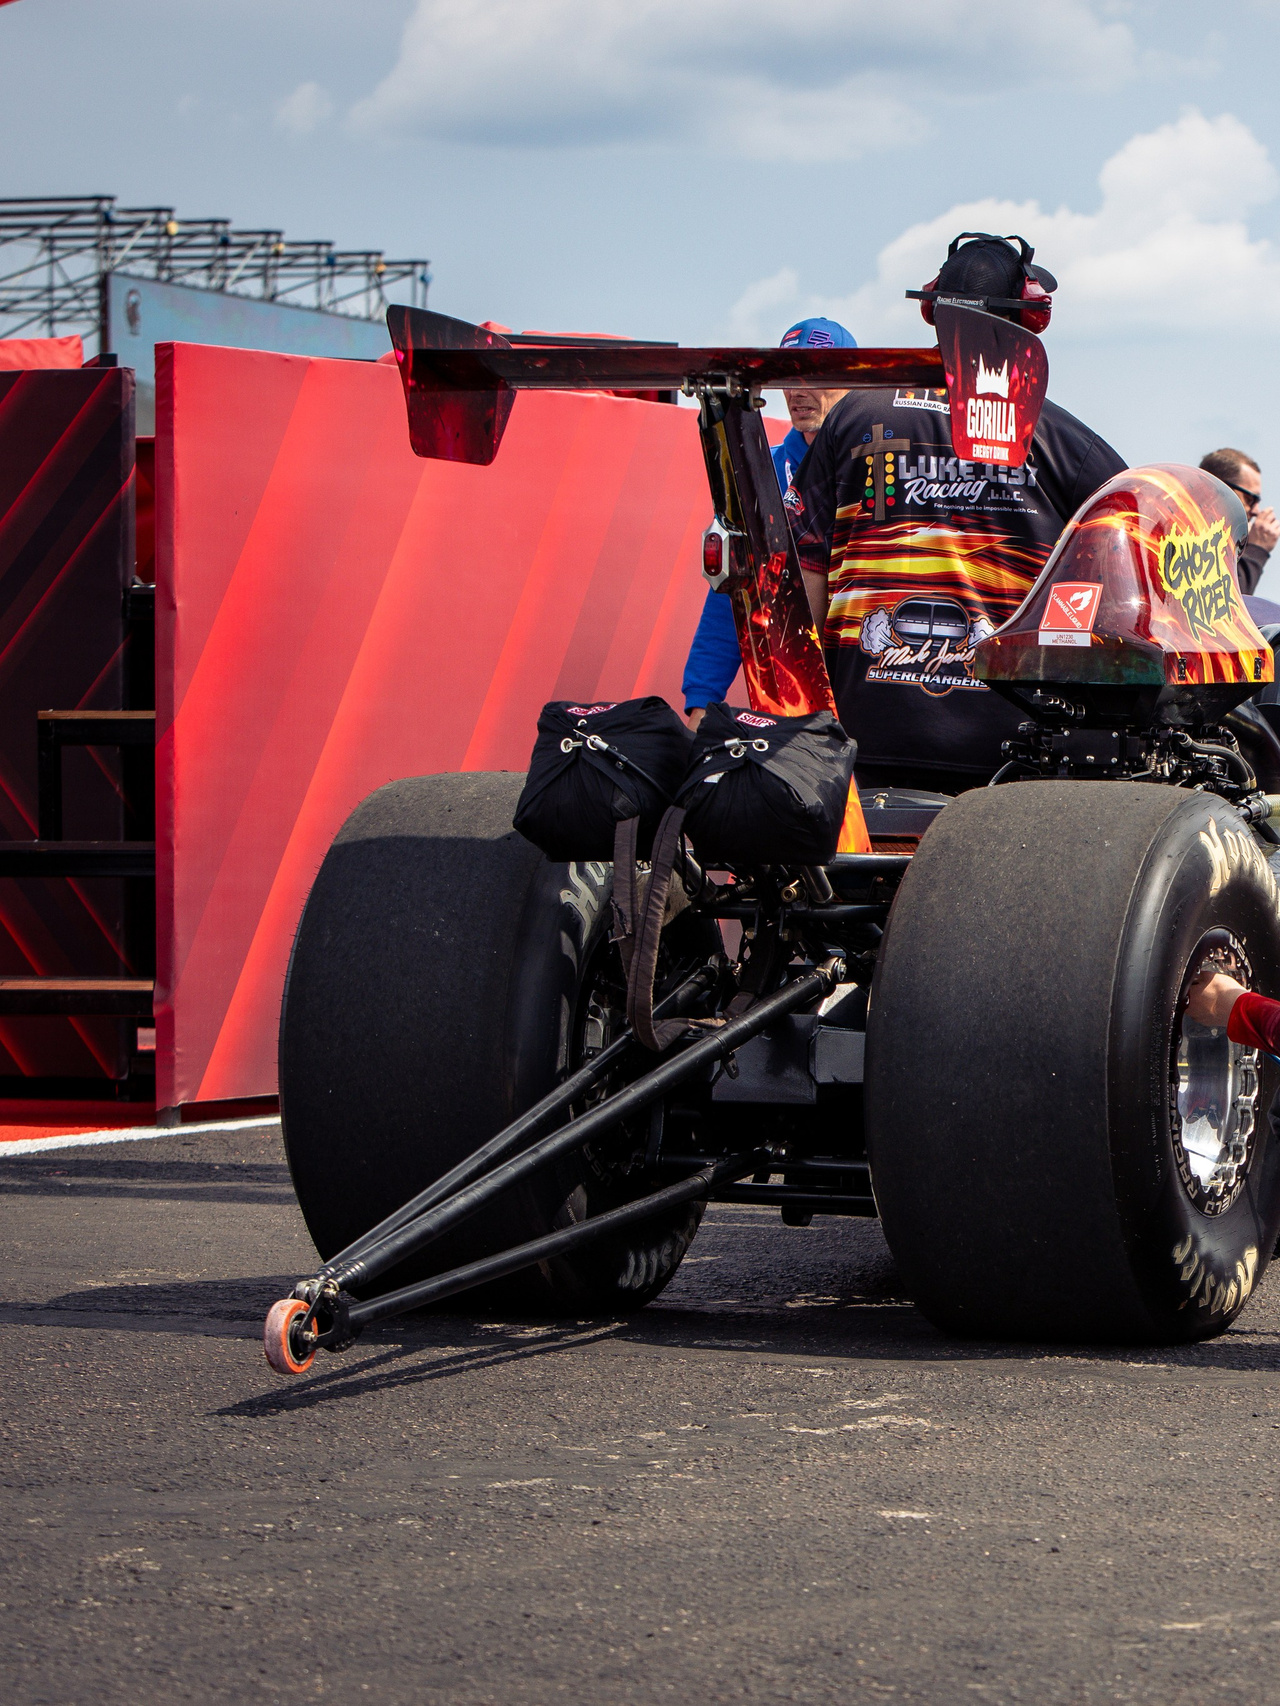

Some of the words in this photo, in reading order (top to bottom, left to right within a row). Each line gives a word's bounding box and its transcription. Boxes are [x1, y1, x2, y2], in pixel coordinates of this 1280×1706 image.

[923, 402, 942, 410] DRAG
[966, 398, 1016, 442] GORILLA
[972, 444, 993, 459] ENERGY
[993, 446, 1009, 461] DRINK
[898, 454, 976, 482] LUKE
[904, 477, 988, 506] Racing
[1164, 530, 1223, 590] GHOST
[1182, 573, 1239, 641] RIDER
